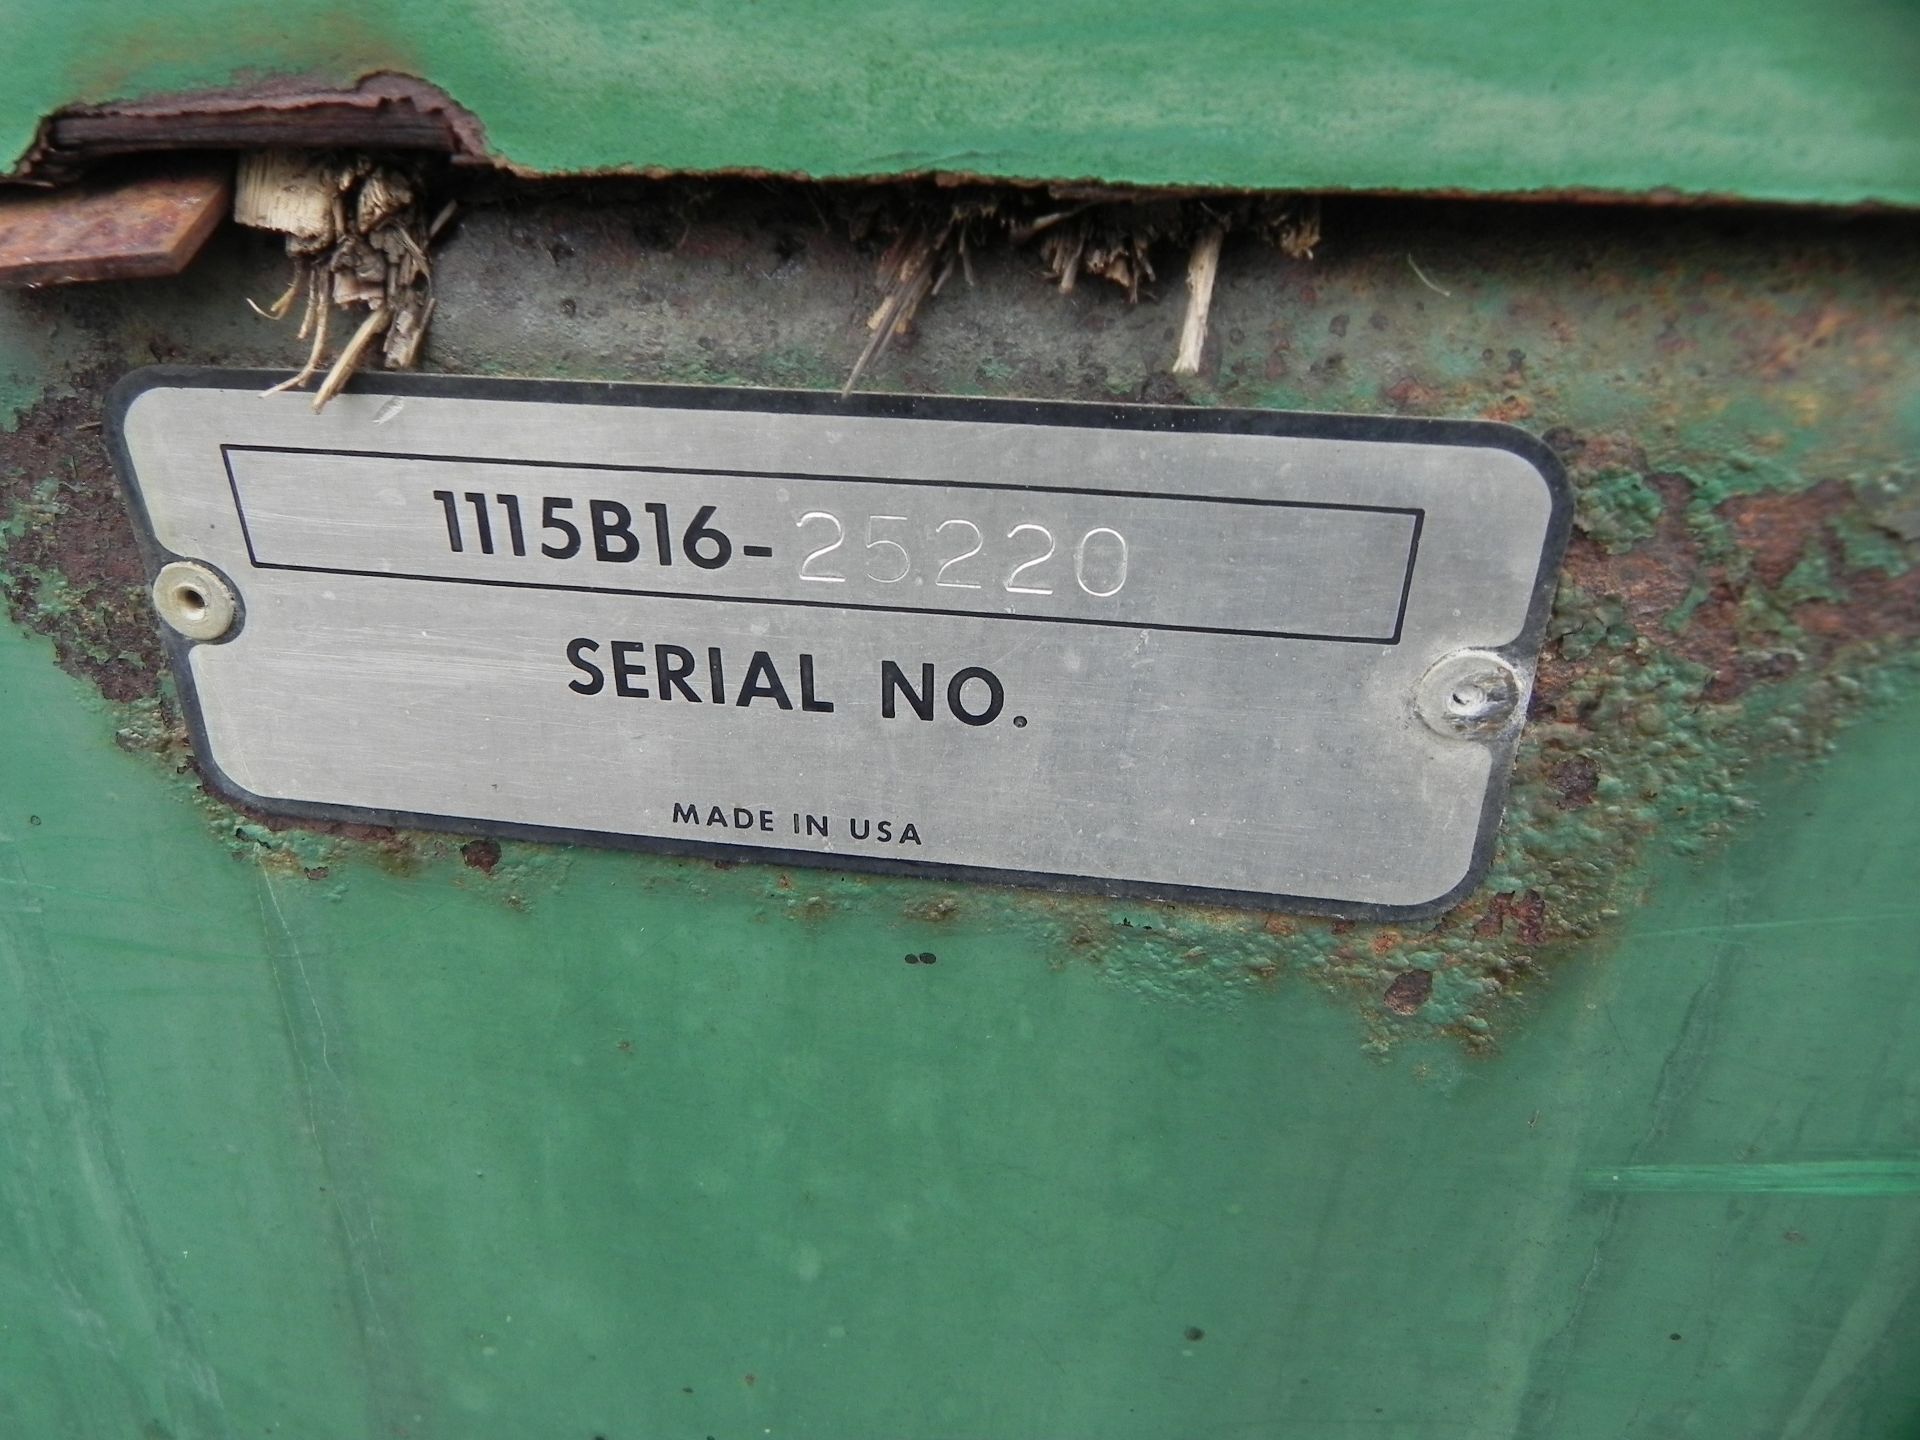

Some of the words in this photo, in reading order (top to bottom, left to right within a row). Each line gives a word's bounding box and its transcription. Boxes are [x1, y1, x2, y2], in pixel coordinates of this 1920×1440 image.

[566, 637, 834, 713] SERIAL
[881, 660, 1028, 728] NO.
[672, 802, 774, 832] MADE
[793, 813, 829, 837] IN
[850, 818, 922, 846] USA
